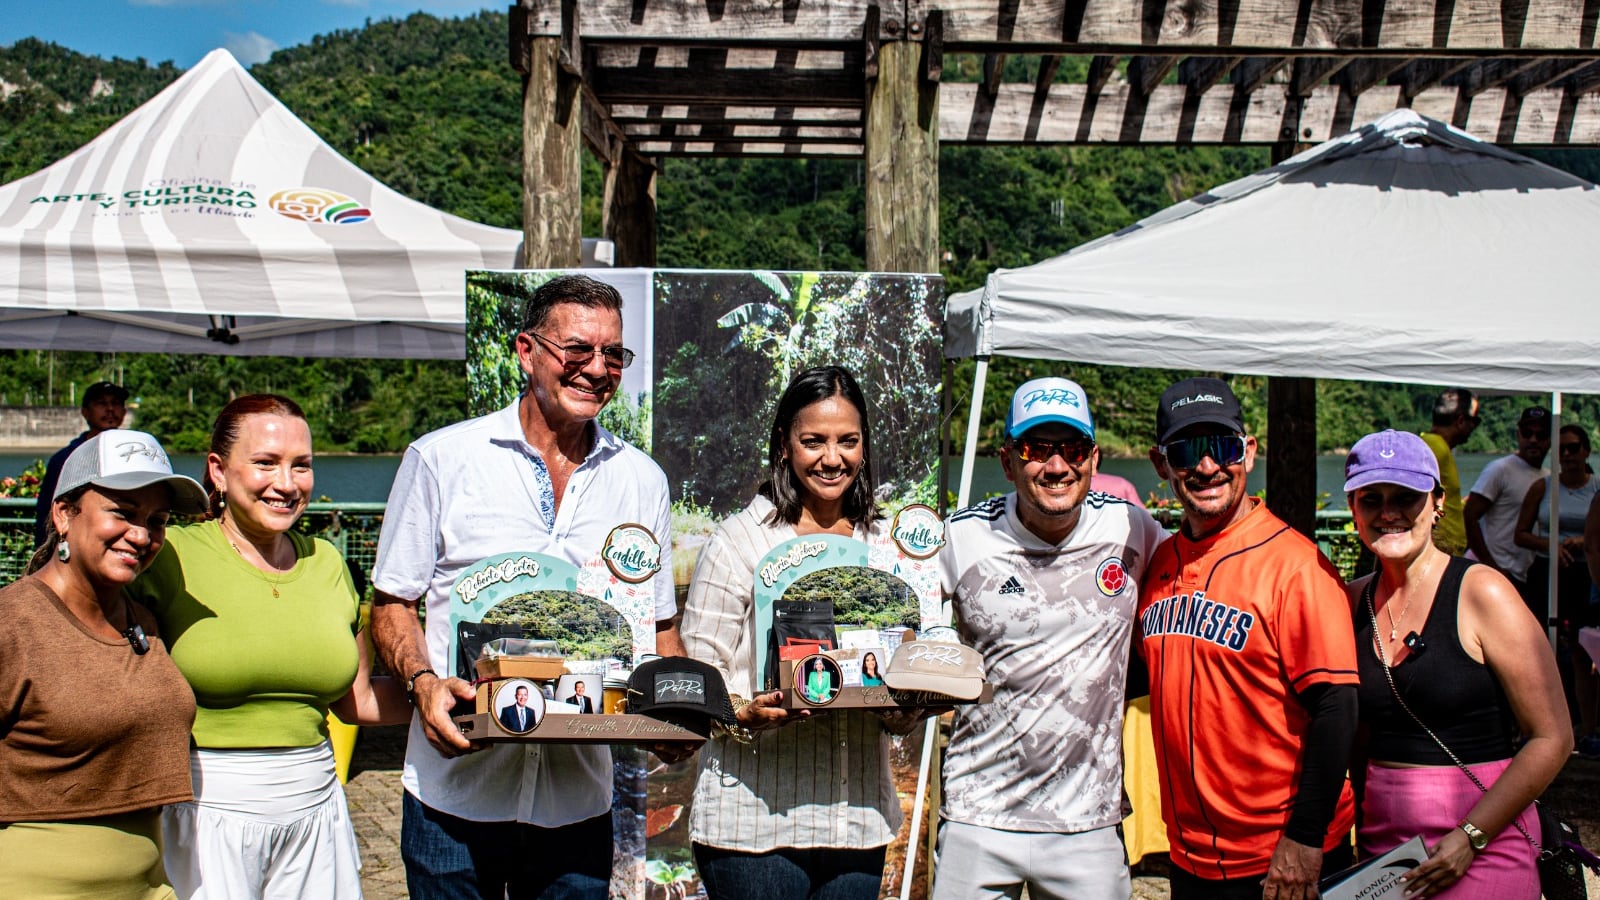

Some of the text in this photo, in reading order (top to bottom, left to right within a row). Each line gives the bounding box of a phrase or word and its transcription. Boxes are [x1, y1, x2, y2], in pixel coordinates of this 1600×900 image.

[149, 176, 257, 190] Oficina de
[29, 184, 257, 204] ARTE, CULTURA
[98, 195, 258, 210] Y TURISMO
[1171, 394, 1224, 412] PELAGIC
[459, 568, 500, 600] Roberto
[998, 586, 1025, 595] adidas
[1354, 871, 1397, 900] MONICA
